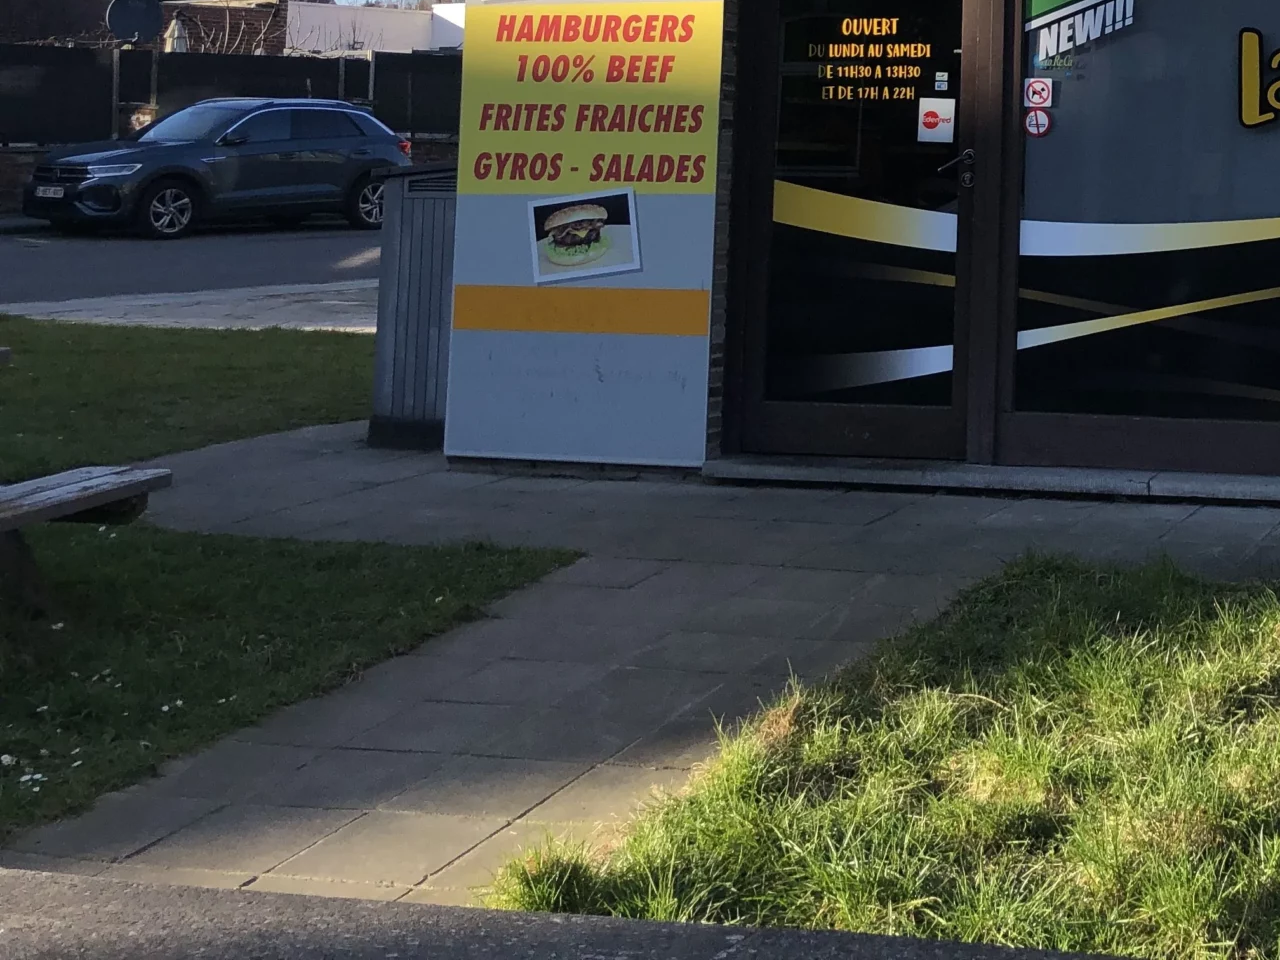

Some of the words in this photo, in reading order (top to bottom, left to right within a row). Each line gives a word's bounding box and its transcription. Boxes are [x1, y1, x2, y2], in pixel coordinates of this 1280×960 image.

[495, 14, 696, 43] HAMBURGERS
[842, 18, 899, 36] OUVERT
[808, 43, 825, 58] DU
[828, 43, 864, 58] LUNDI
[867, 43, 883, 58] AU
[886, 43, 931, 58] SAMEDI
[516, 54, 597, 83] 100%
[605, 55, 676, 83] BEEF
[818, 65, 834, 79] DE
[837, 65, 872, 79] 11H30
[885, 65, 921, 79] 13H30
[822, 86, 835, 100] ET
[838, 86, 854, 100] DE
[857, 86, 879, 100] 17H
[893, 86, 915, 100] 22H
[479, 103, 568, 132] FRITES
[574, 104, 705, 133] FRAICHES
[473, 152, 563, 181] GYROS
[589, 153, 707, 183] SALADES
